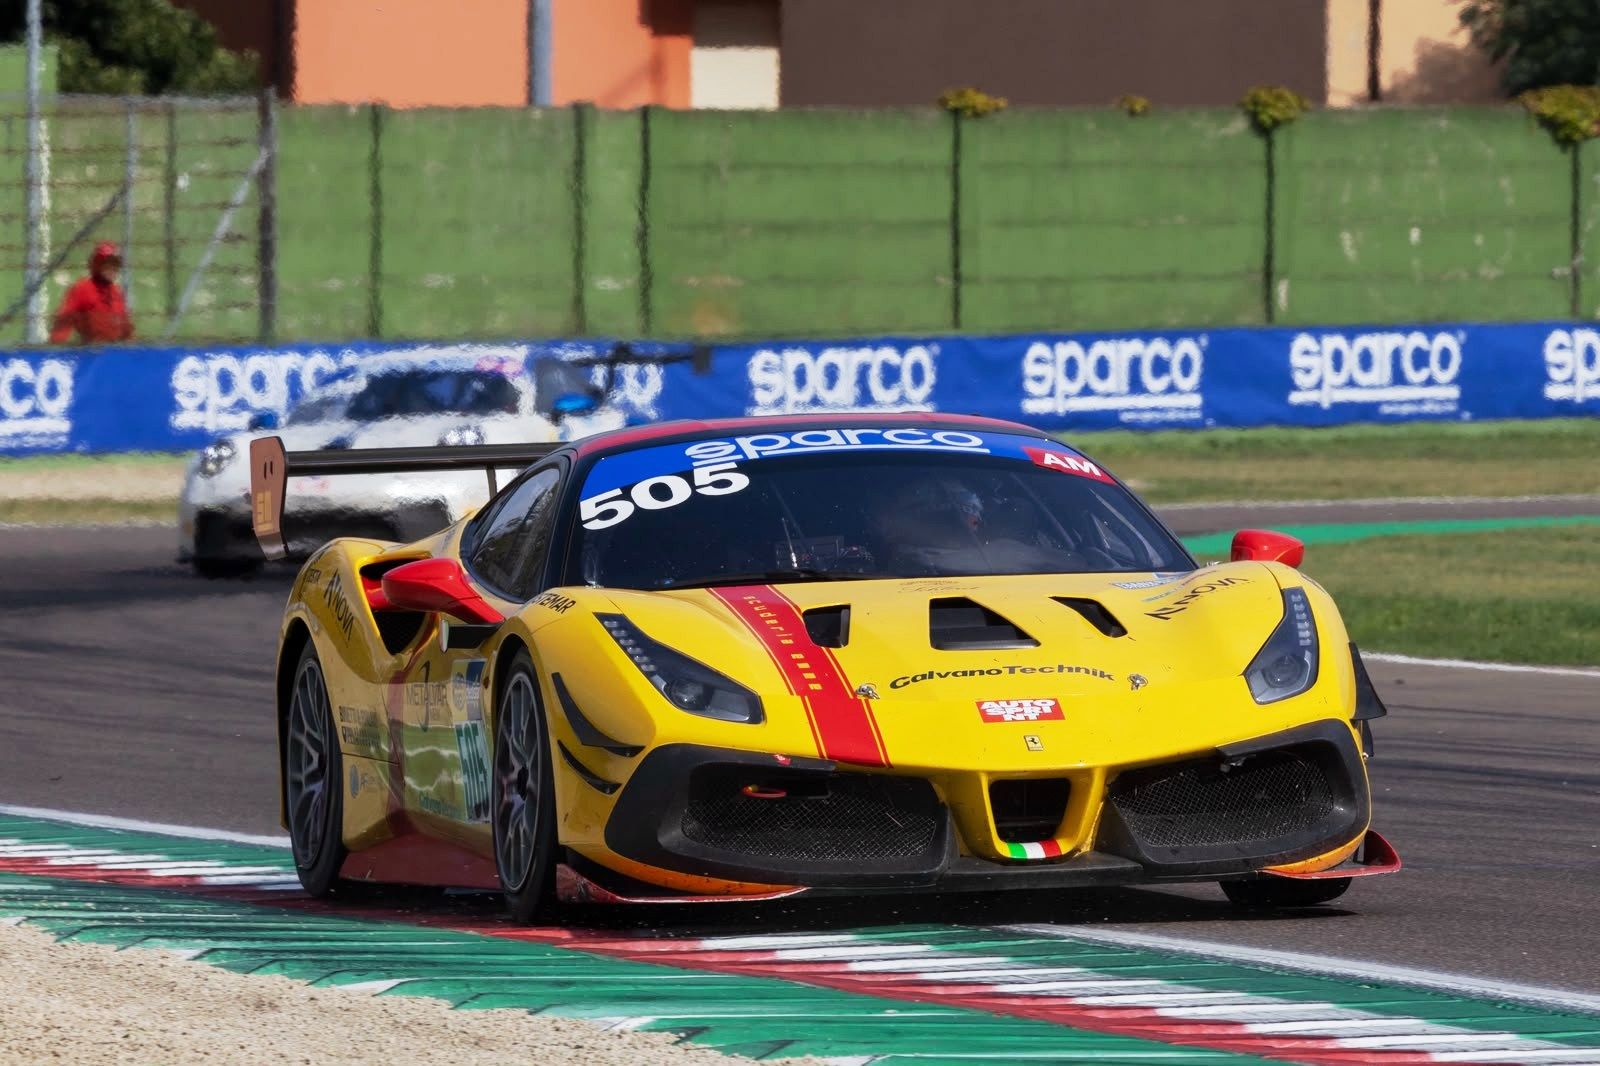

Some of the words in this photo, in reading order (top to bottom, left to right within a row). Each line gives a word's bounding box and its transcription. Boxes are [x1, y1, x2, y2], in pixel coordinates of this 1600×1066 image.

[747, 346, 938, 413] sparco
[1022, 337, 1203, 415] sparco
[1290, 331, 1461, 408] sparco
[172, 350, 360, 432] sparc
[685, 429, 984, 461] sparco
[1044, 453, 1101, 477] AM
[579, 462, 750, 530] 505
[889, 664, 1115, 690] GalvanoTechnik
[981, 699, 1056, 710] AUTO
[985, 706, 1053, 716] SPRI
[1003, 713, 1040, 721] NT
